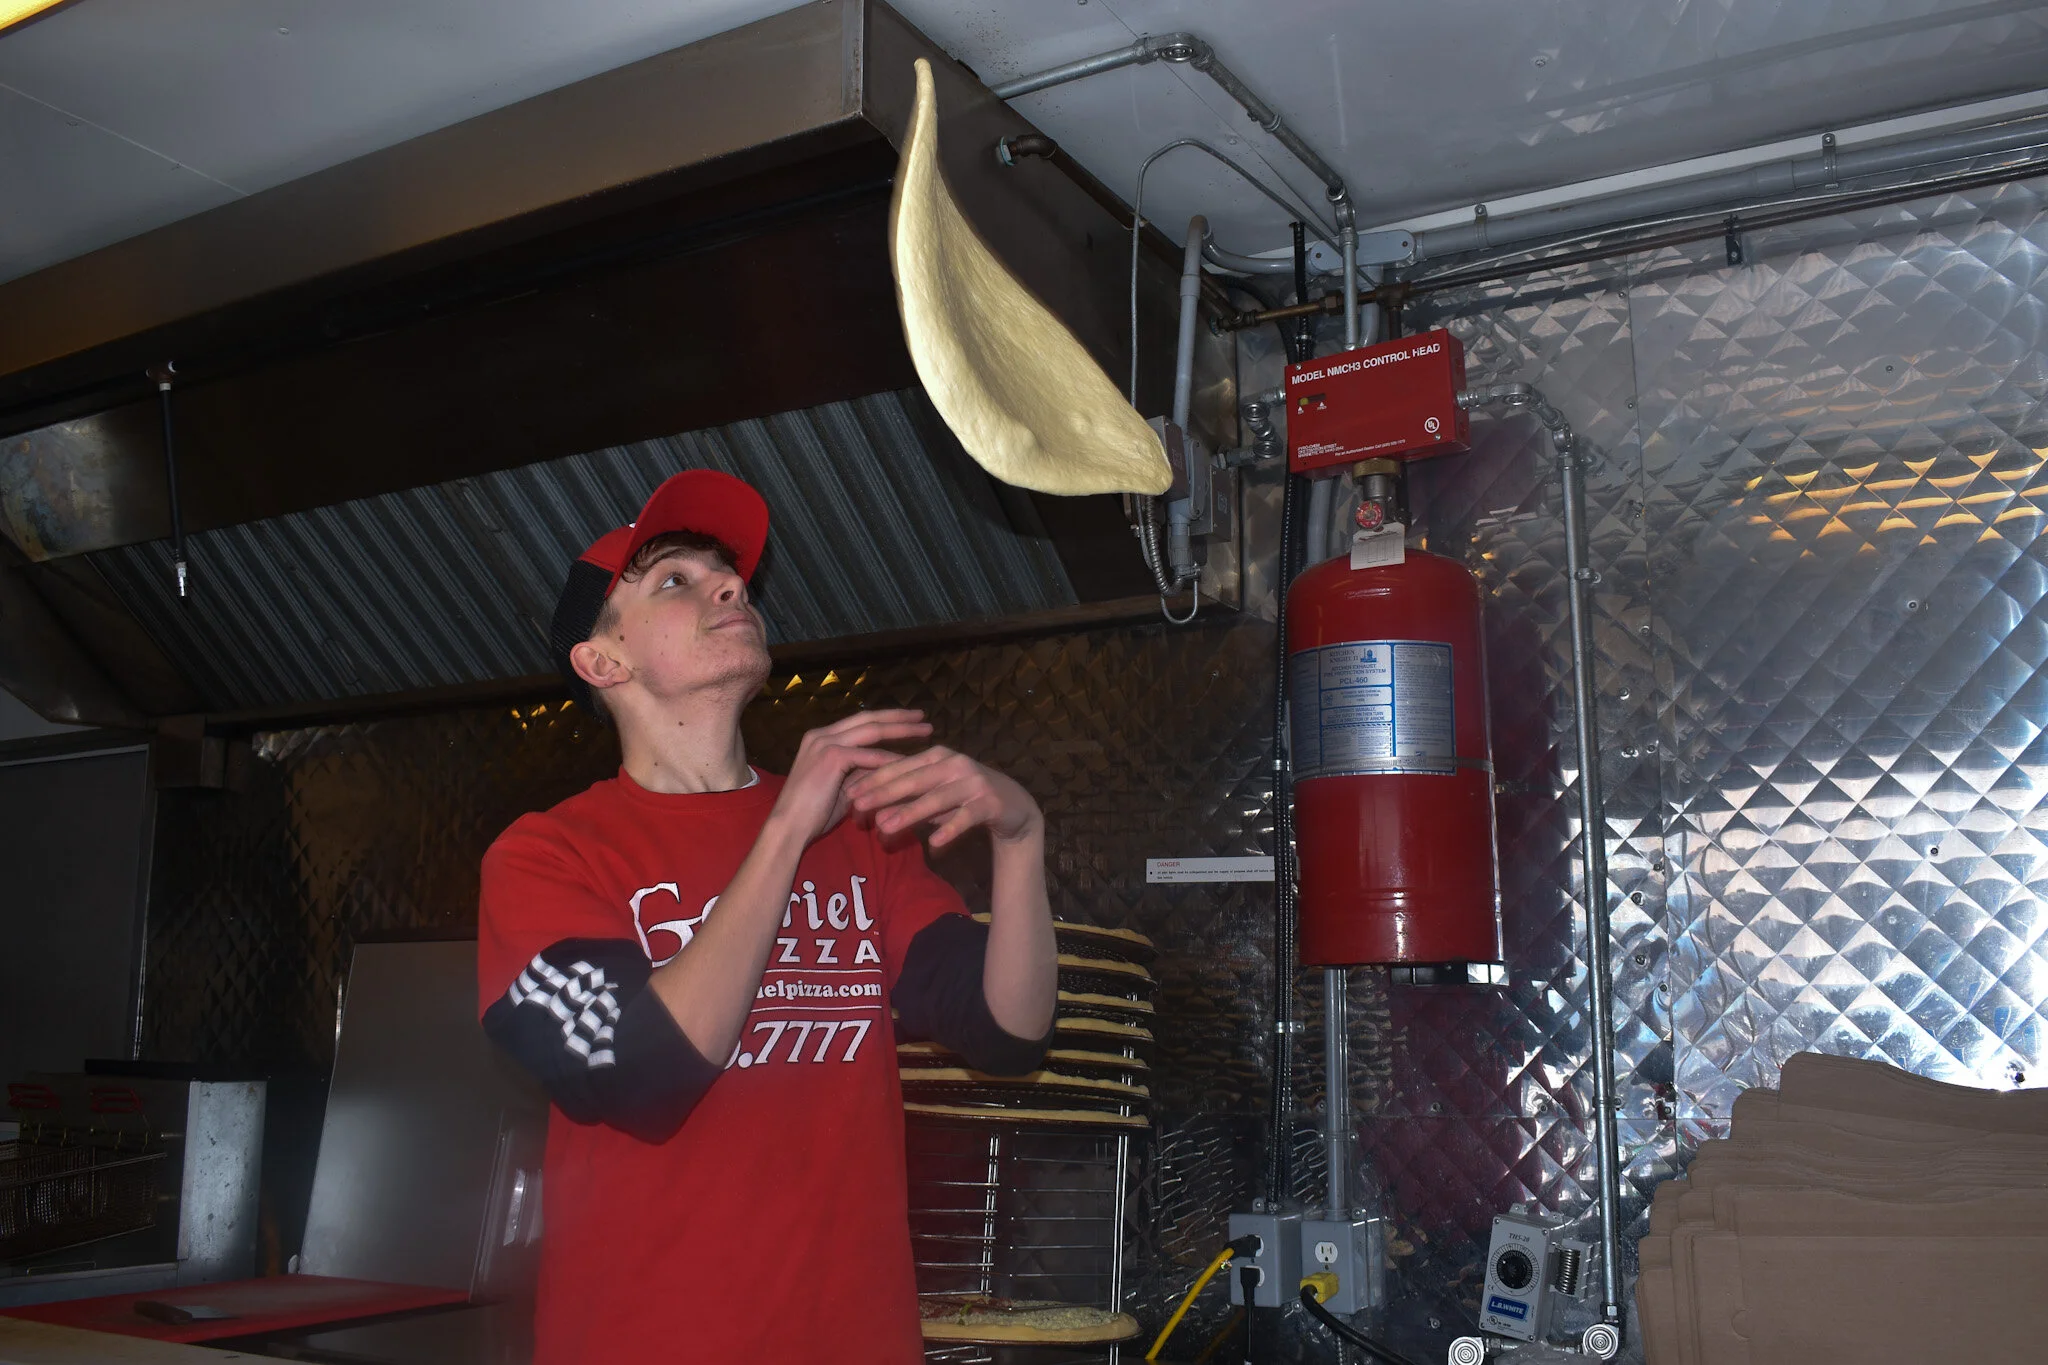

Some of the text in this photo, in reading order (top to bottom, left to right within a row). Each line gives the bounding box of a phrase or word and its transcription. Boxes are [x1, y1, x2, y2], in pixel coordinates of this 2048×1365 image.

[1291, 343, 1441, 385] MODEL NMCH3 CONTROL HEAD
[1339, 676, 1368, 685] PCL-460
[629, 875, 874, 968] Griel
[777, 938, 881, 964] ZZA
[724, 1019, 872, 1070] .7777
